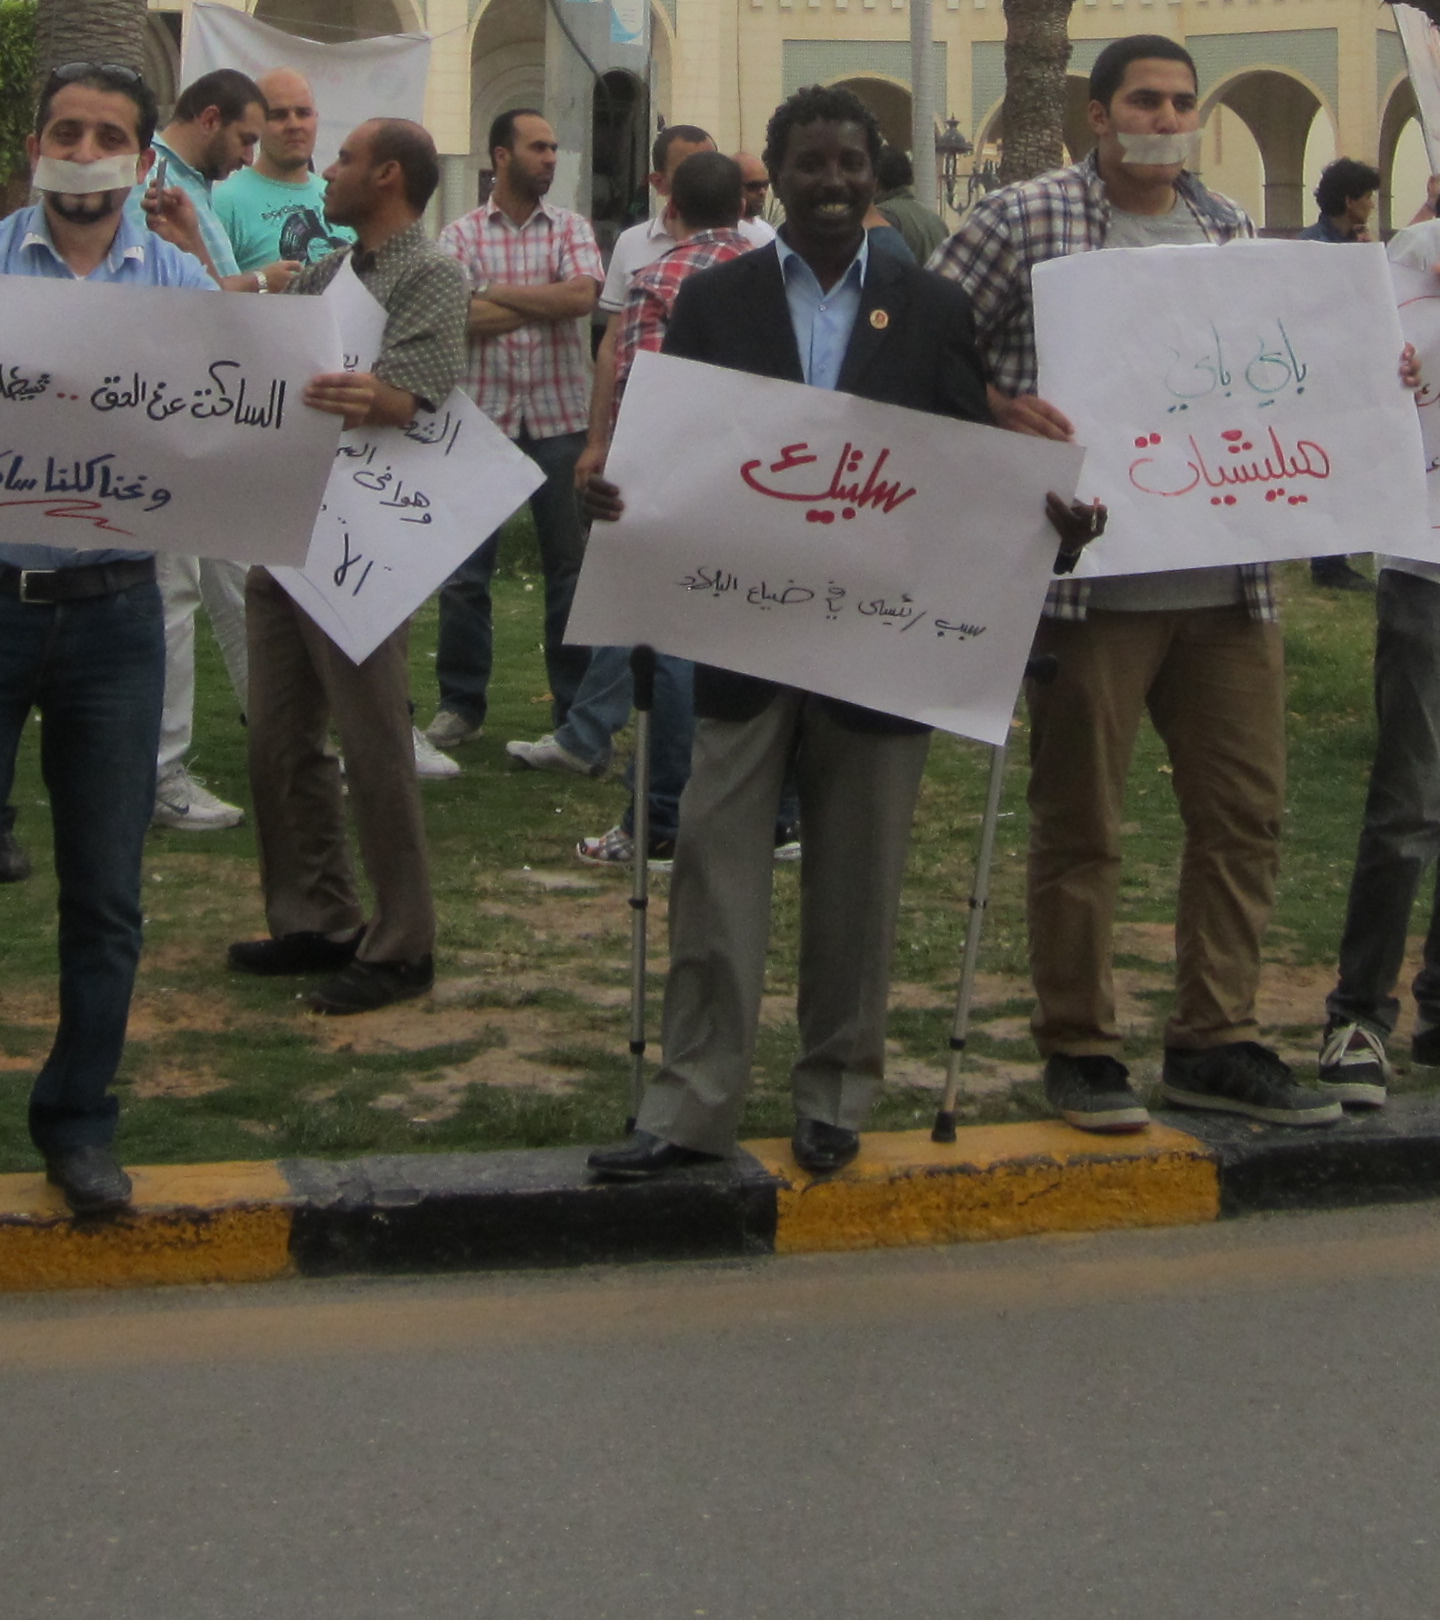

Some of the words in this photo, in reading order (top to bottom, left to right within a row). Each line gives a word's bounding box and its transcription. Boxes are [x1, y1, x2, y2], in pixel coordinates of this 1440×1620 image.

[90, 372, 147, 412] الحق
[147, 381, 187, 422] عن
[191, 361, 286, 429] الساكت
